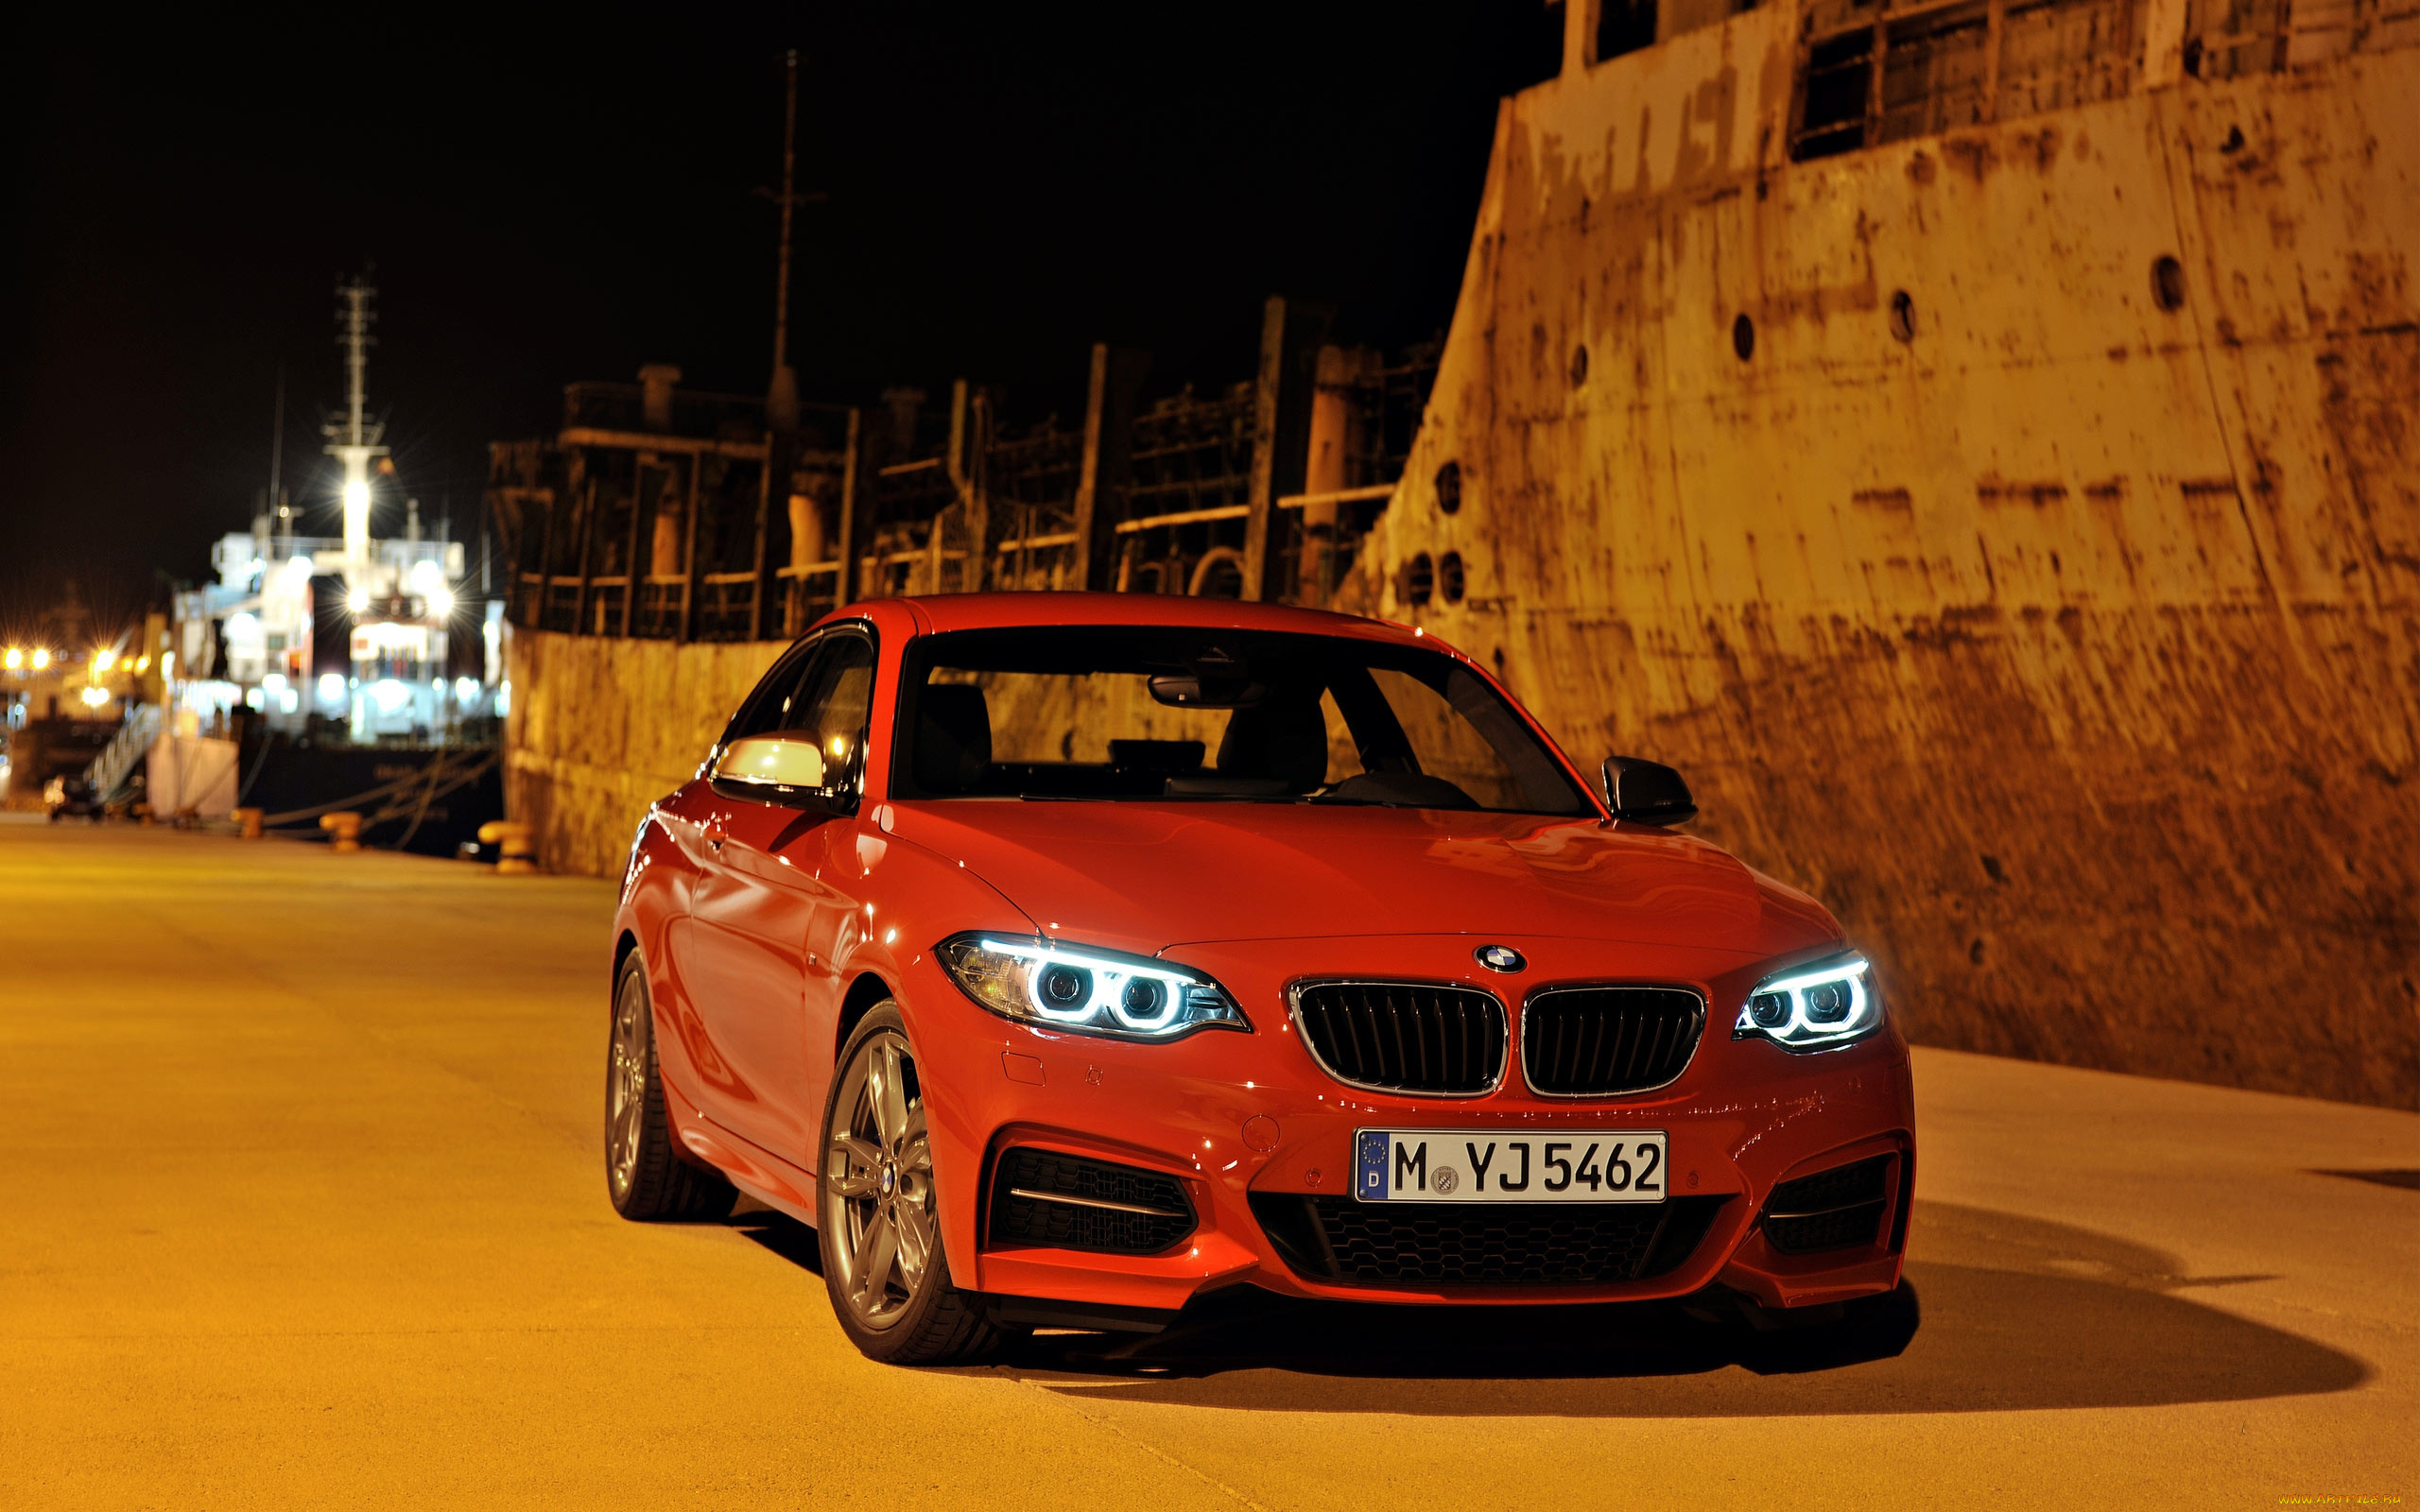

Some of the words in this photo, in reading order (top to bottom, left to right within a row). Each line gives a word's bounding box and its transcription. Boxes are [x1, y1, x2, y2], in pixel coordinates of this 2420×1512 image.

[1367, 1171, 1380, 1189] D
[1394, 1142, 1426, 1192] M
[1466, 1142, 1530, 1193] YJ
[1544, 1143, 1661, 1193] 5462
